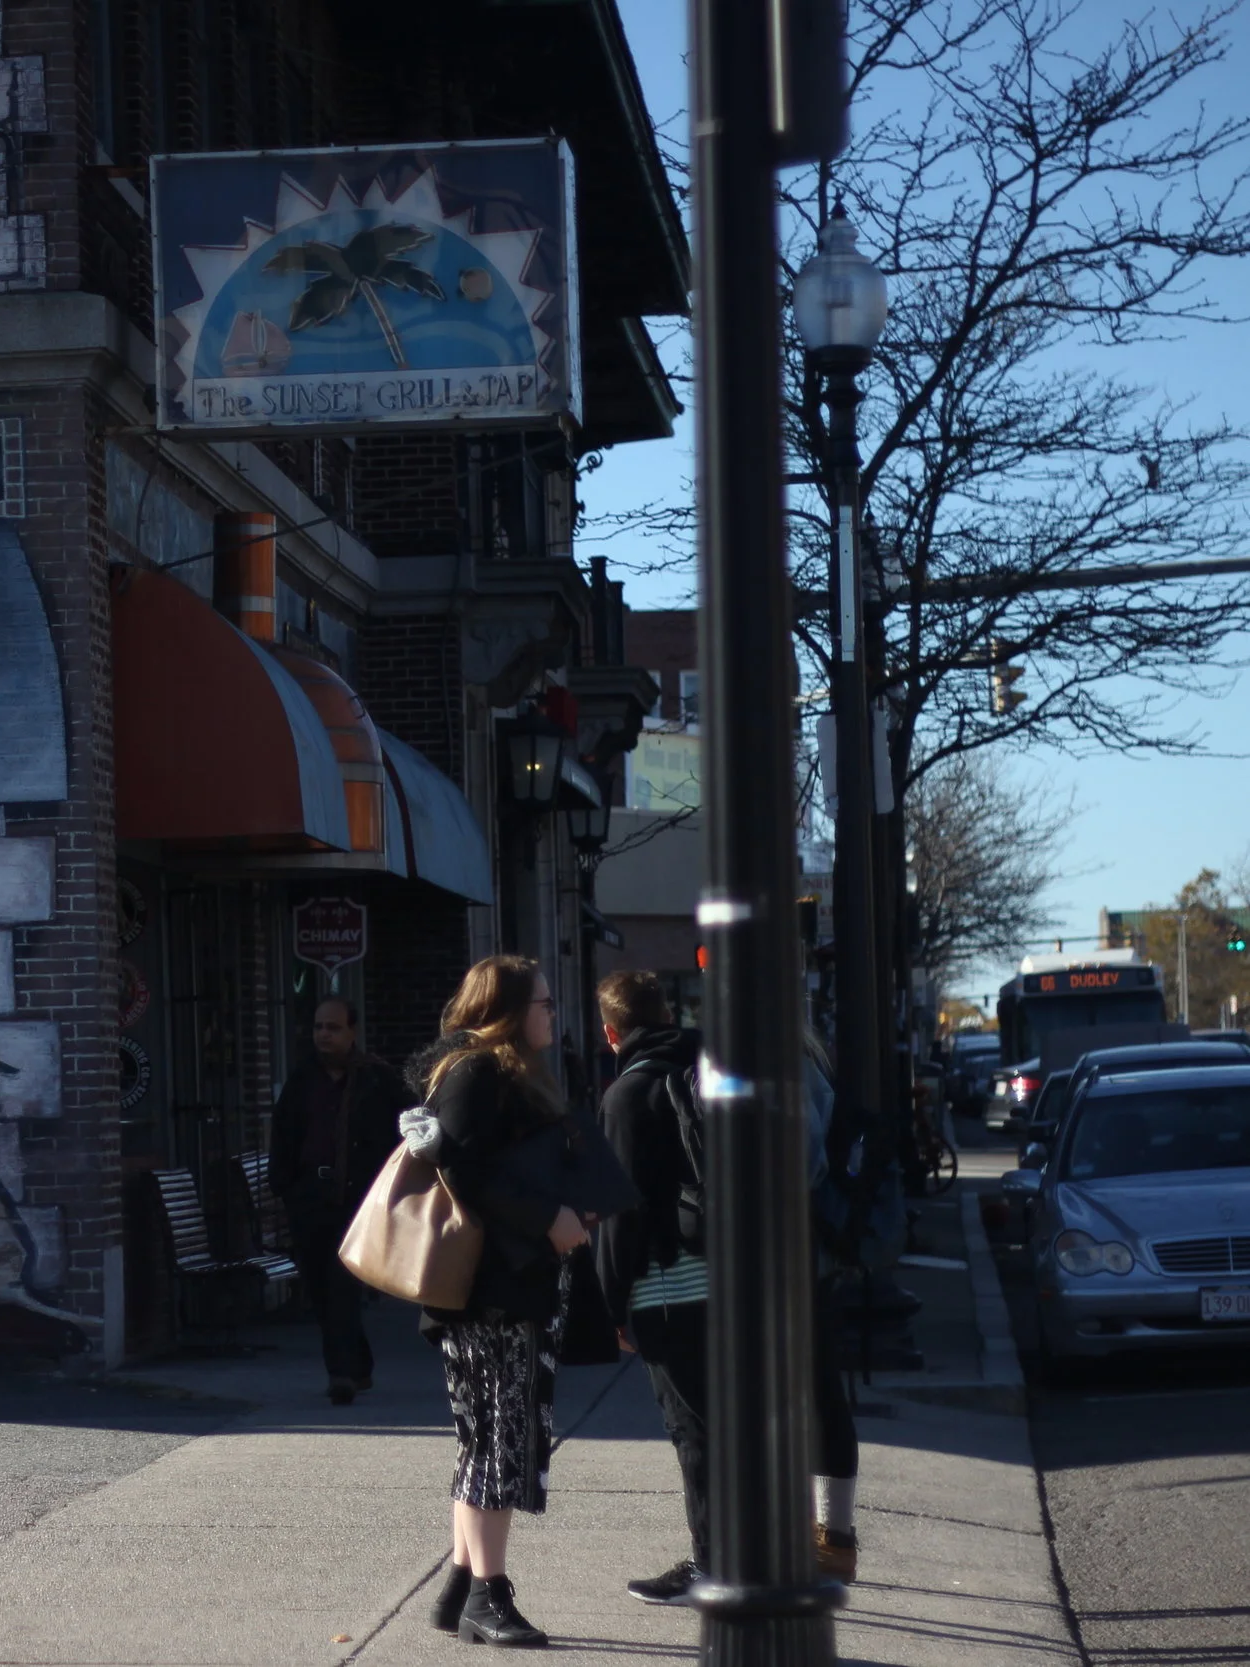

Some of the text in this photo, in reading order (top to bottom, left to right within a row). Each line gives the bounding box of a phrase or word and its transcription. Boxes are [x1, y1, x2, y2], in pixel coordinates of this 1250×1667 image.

[196, 386, 255, 419] The
[261, 381, 366, 416] SUNSET
[376, 377, 461, 410] GRILL
[479, 373, 534, 407] TAP
[298, 928, 362, 943] CHIMAY
[1069, 971, 1120, 990] DUDLEY
[1204, 1295, 1232, 1314] 139
